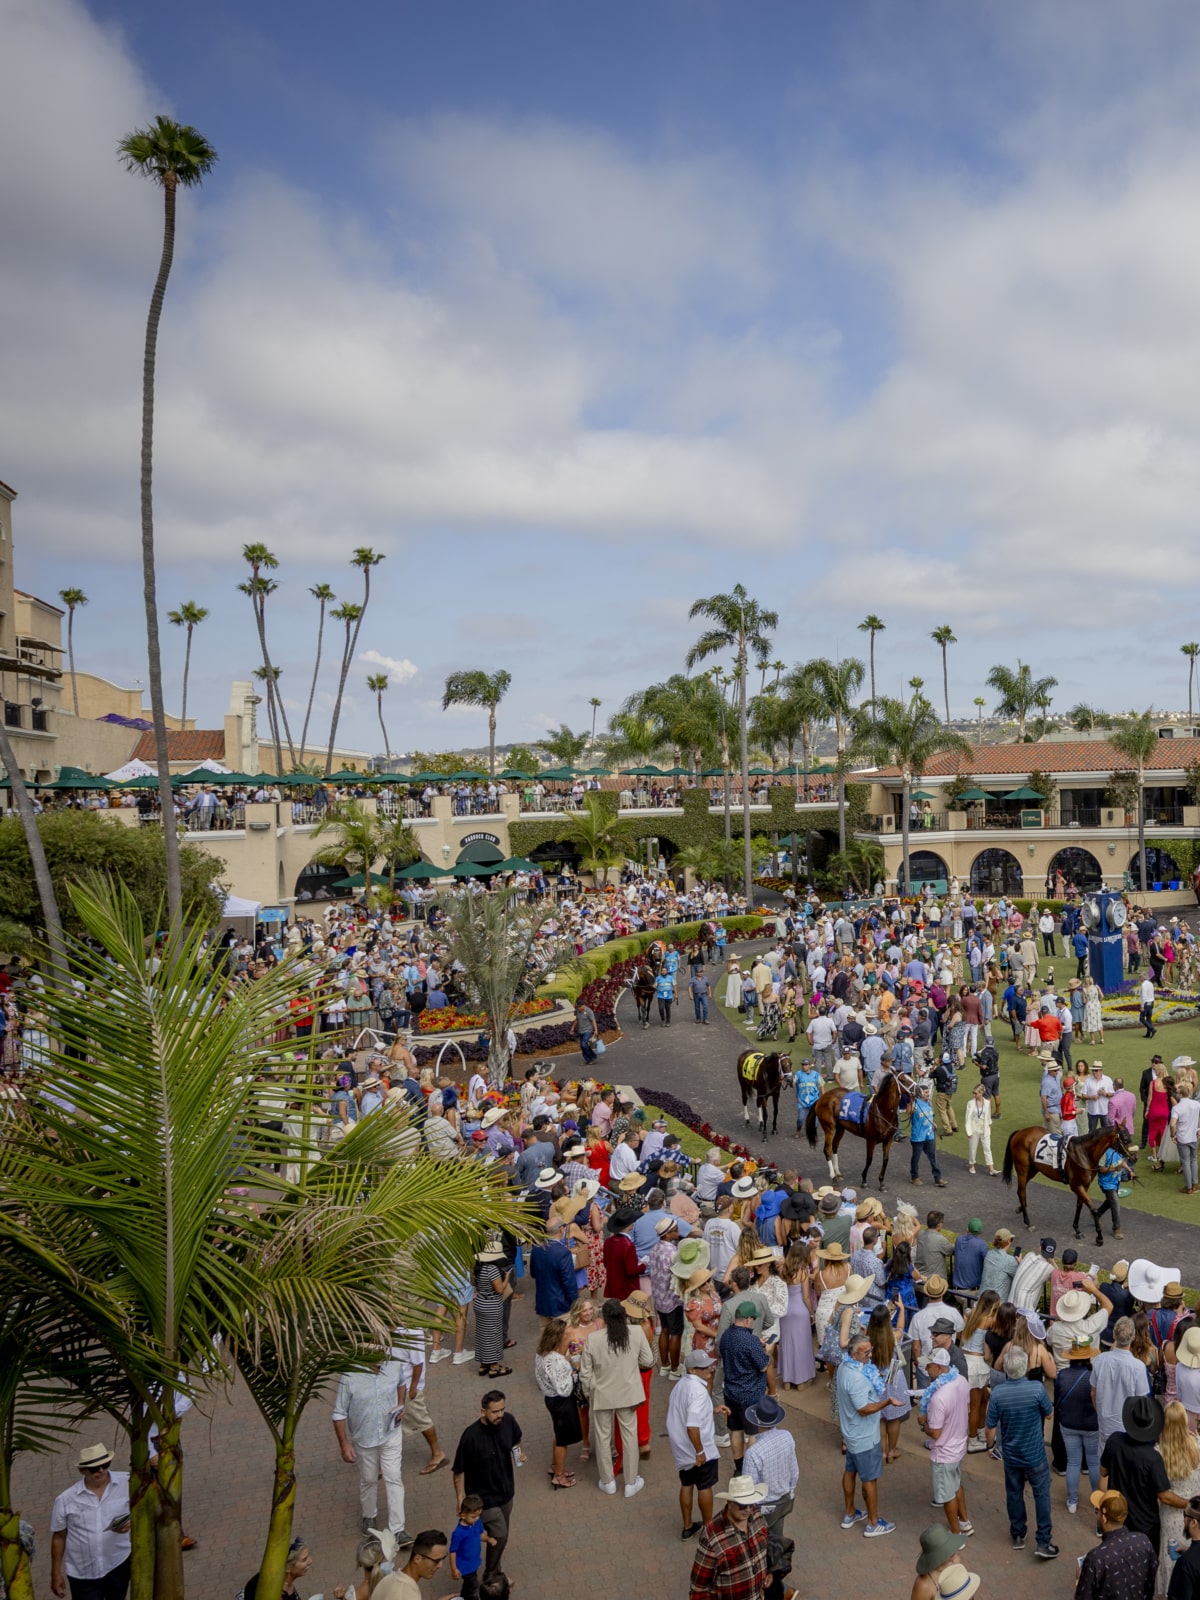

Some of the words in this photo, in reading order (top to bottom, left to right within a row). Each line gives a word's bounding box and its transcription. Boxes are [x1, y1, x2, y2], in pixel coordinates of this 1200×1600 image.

[464, 834, 484, 843] PADDOCK
[1104, 934, 1122, 942] LONGINES
[840, 1098, 850, 1118] 3
[1036, 1140, 1048, 1160] 2
